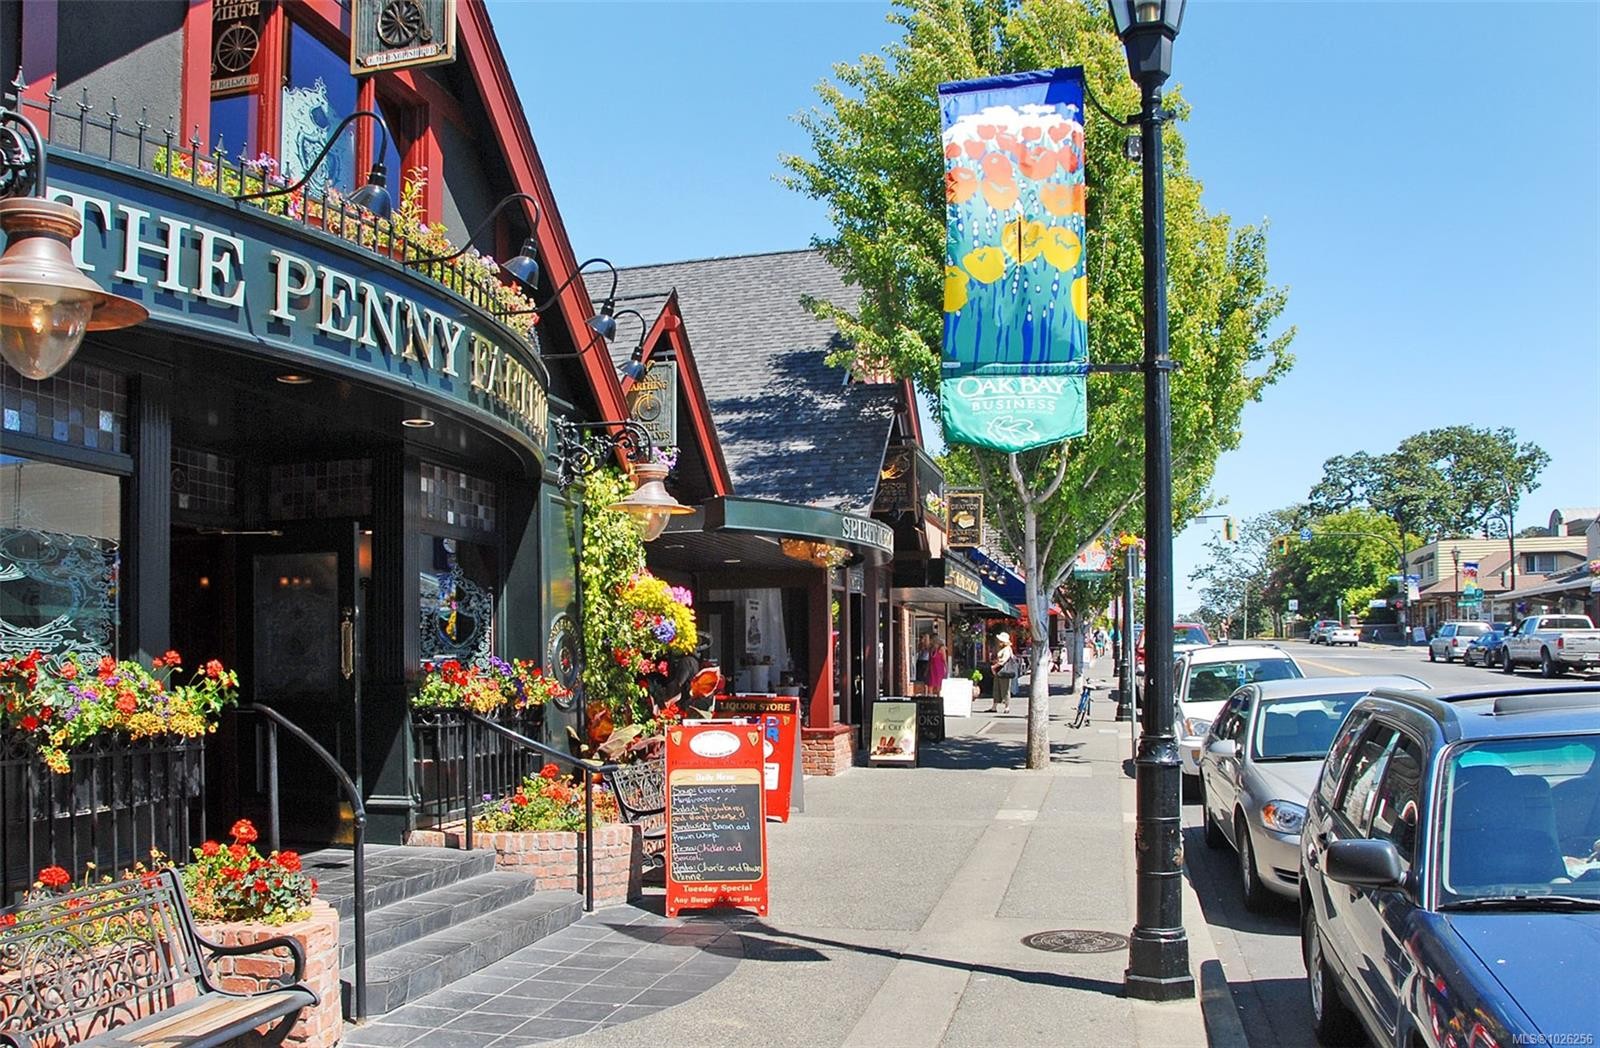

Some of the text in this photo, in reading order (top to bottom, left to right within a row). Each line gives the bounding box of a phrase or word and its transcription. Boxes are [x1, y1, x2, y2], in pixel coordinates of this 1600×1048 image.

[47, 186, 245, 307] THE
[269, 245, 466, 377] PENNY
[630, 382, 668, 391] ARTHING
[957, 376, 1068, 398] OAK BAY
[971, 400, 1057, 412] BUSINESS
[720, 702, 791, 711] LIQUOR STORE
[735, 822, 751, 830] and
[726, 842, 742, 852] and
[727, 863, 743, 872] and
[683, 884, 753, 893] Tuesday Special
[674, 896, 688, 904] Any
[690, 896, 716, 904] Burger
